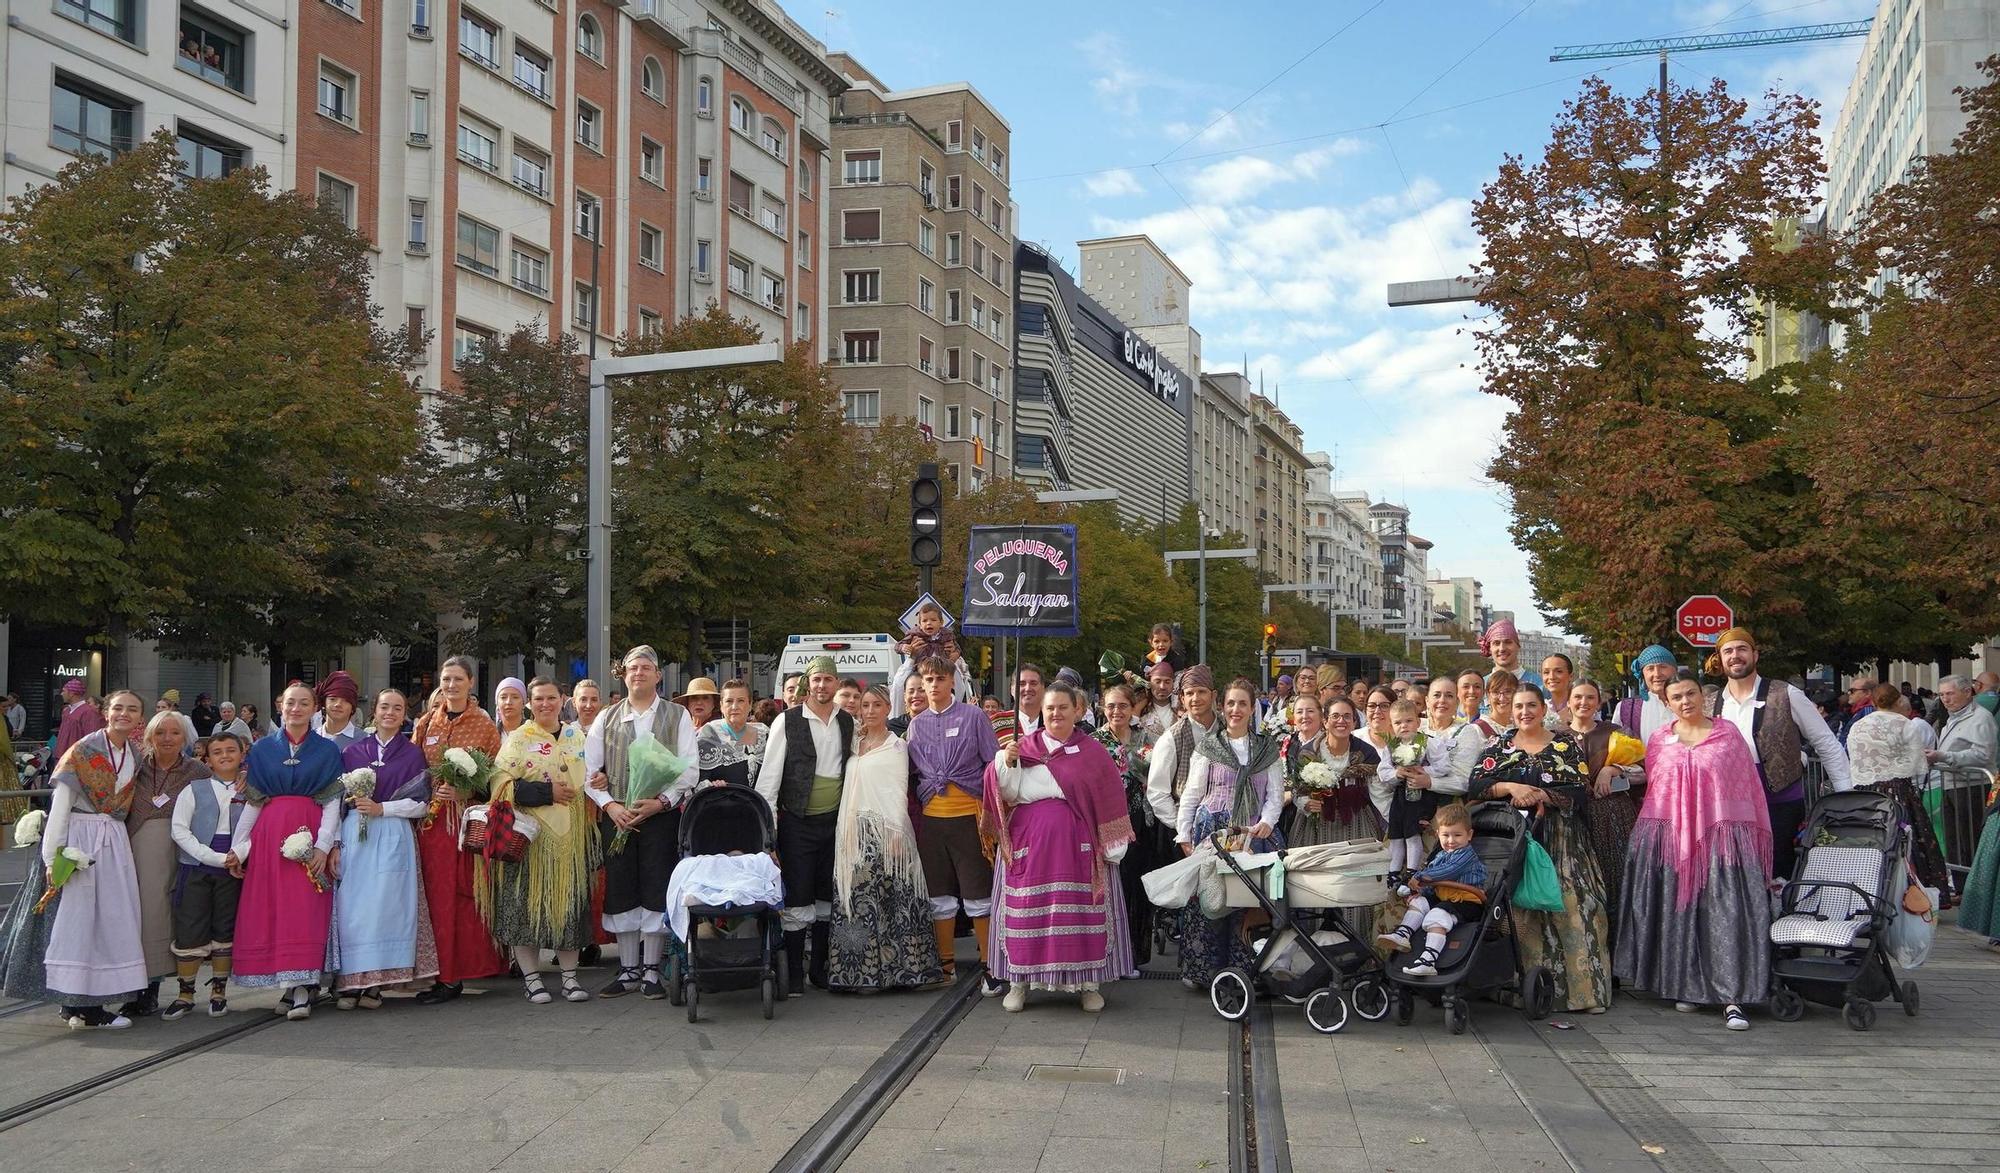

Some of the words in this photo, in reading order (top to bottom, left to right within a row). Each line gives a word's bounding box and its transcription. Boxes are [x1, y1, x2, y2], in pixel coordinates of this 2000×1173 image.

[1125, 330, 1133, 364] El
[1135, 340, 1154, 379] Corte
[970, 571, 1070, 617] Salayan
[1683, 615, 1727, 627] STOP
[795, 654, 877, 665] AMLANCIA
[56, 664, 87, 677] Aural
